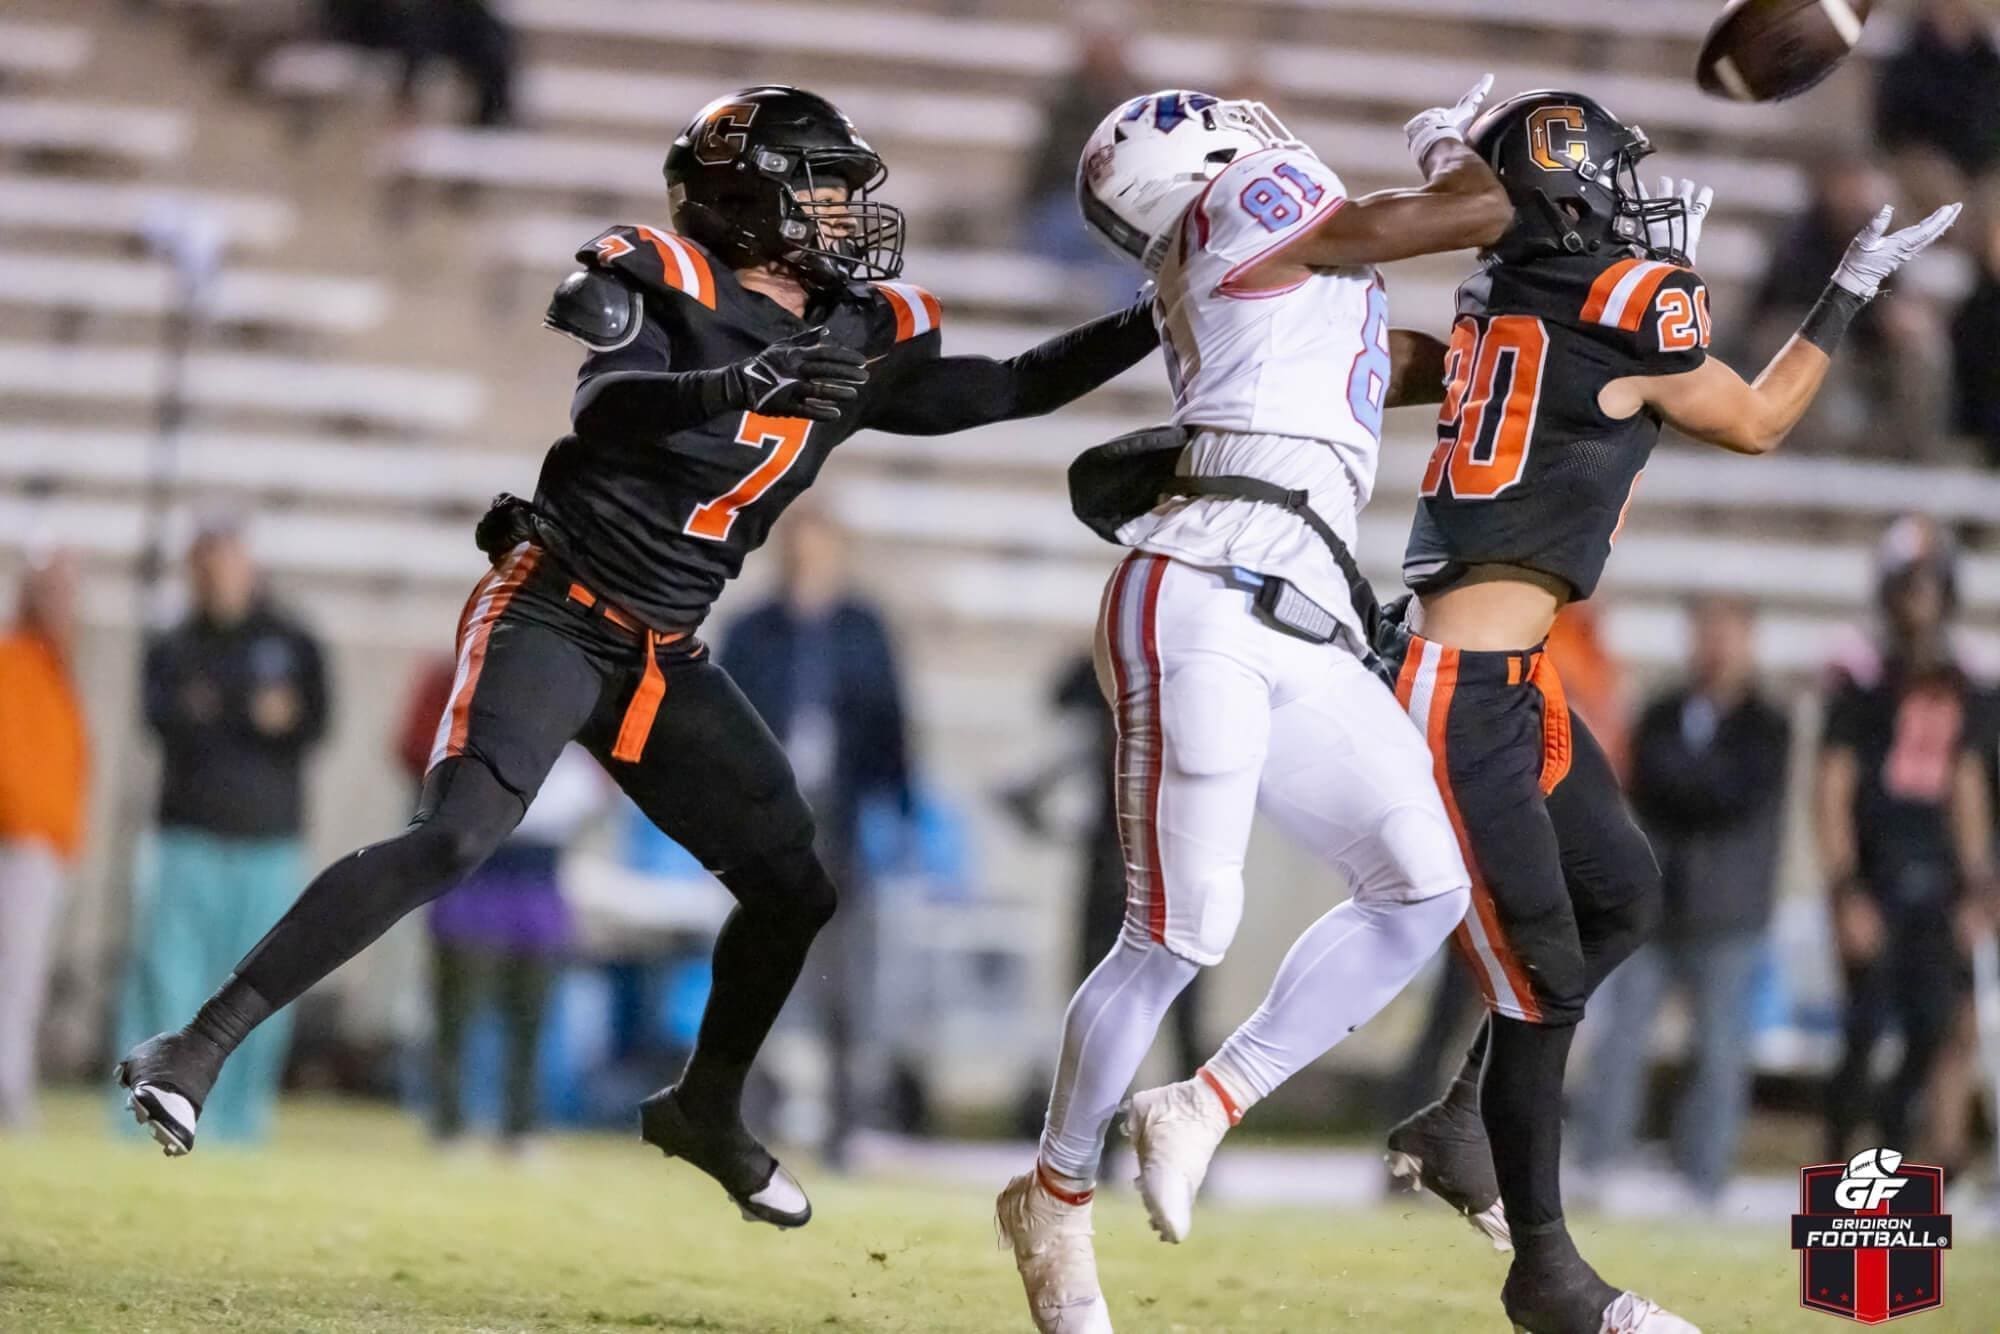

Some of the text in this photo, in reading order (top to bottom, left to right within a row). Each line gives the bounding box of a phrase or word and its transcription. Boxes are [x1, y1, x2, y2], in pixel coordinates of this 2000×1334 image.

[1526, 105, 1589, 171] C
[1239, 162, 1326, 234] 81
[1417, 315, 1550, 500] 20
[682, 410, 814, 542] 7
